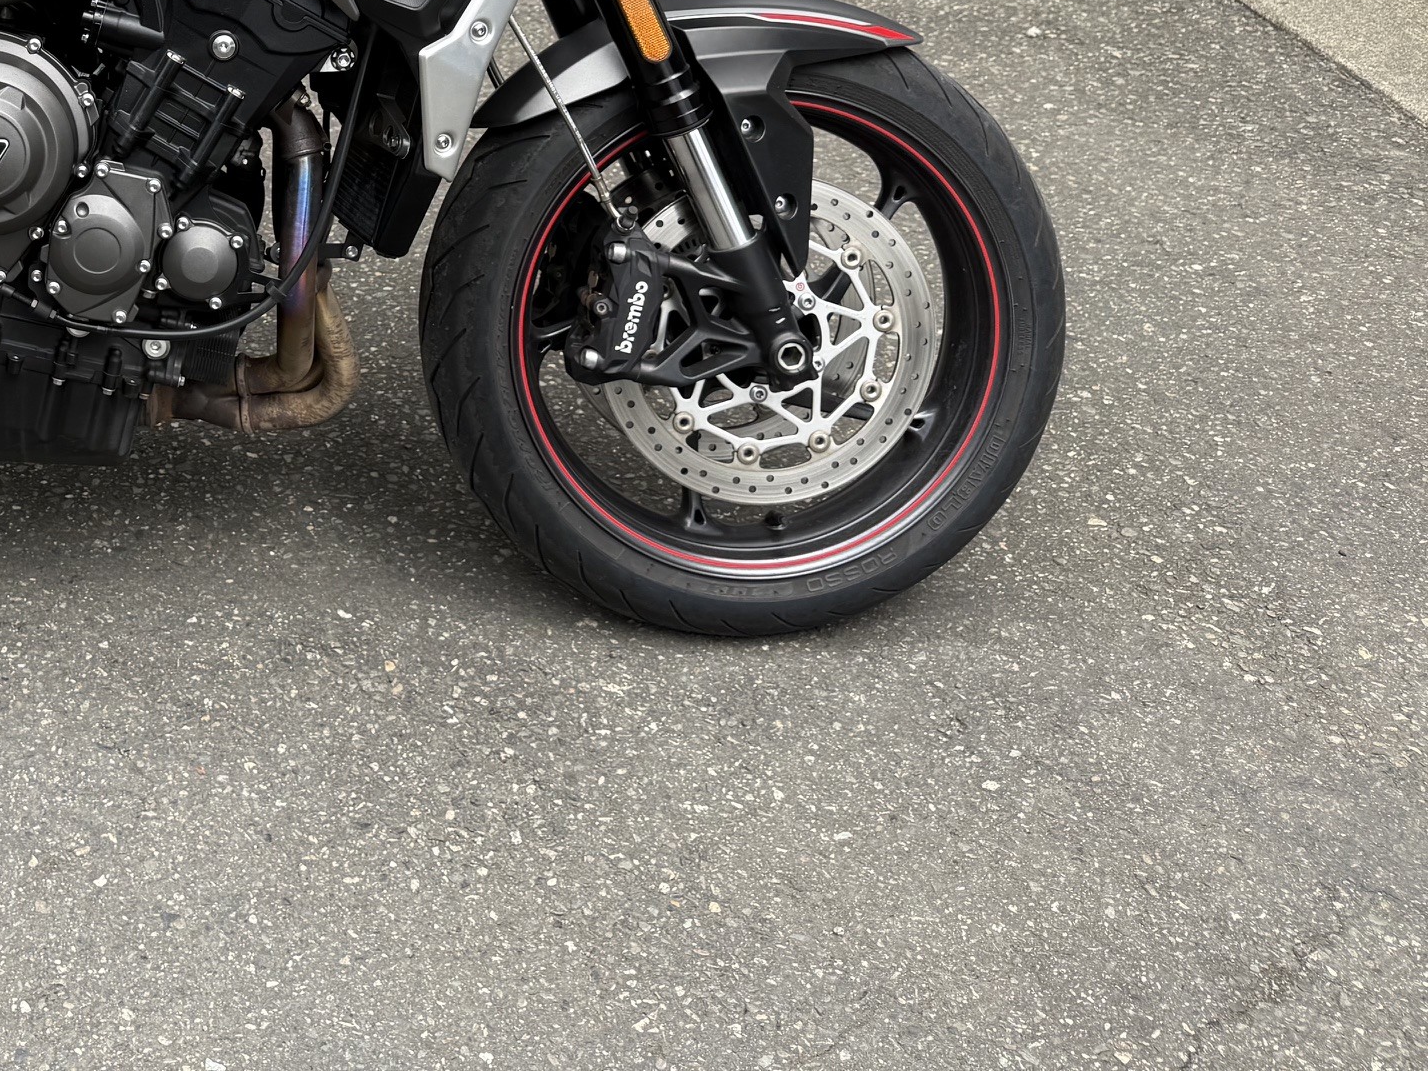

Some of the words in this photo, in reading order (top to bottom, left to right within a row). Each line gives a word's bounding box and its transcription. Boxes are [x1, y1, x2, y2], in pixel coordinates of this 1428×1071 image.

[614, 281, 649, 354] brembo
[926, 435, 1006, 531] DIABLO
[806, 548, 896, 593] ROSSO
